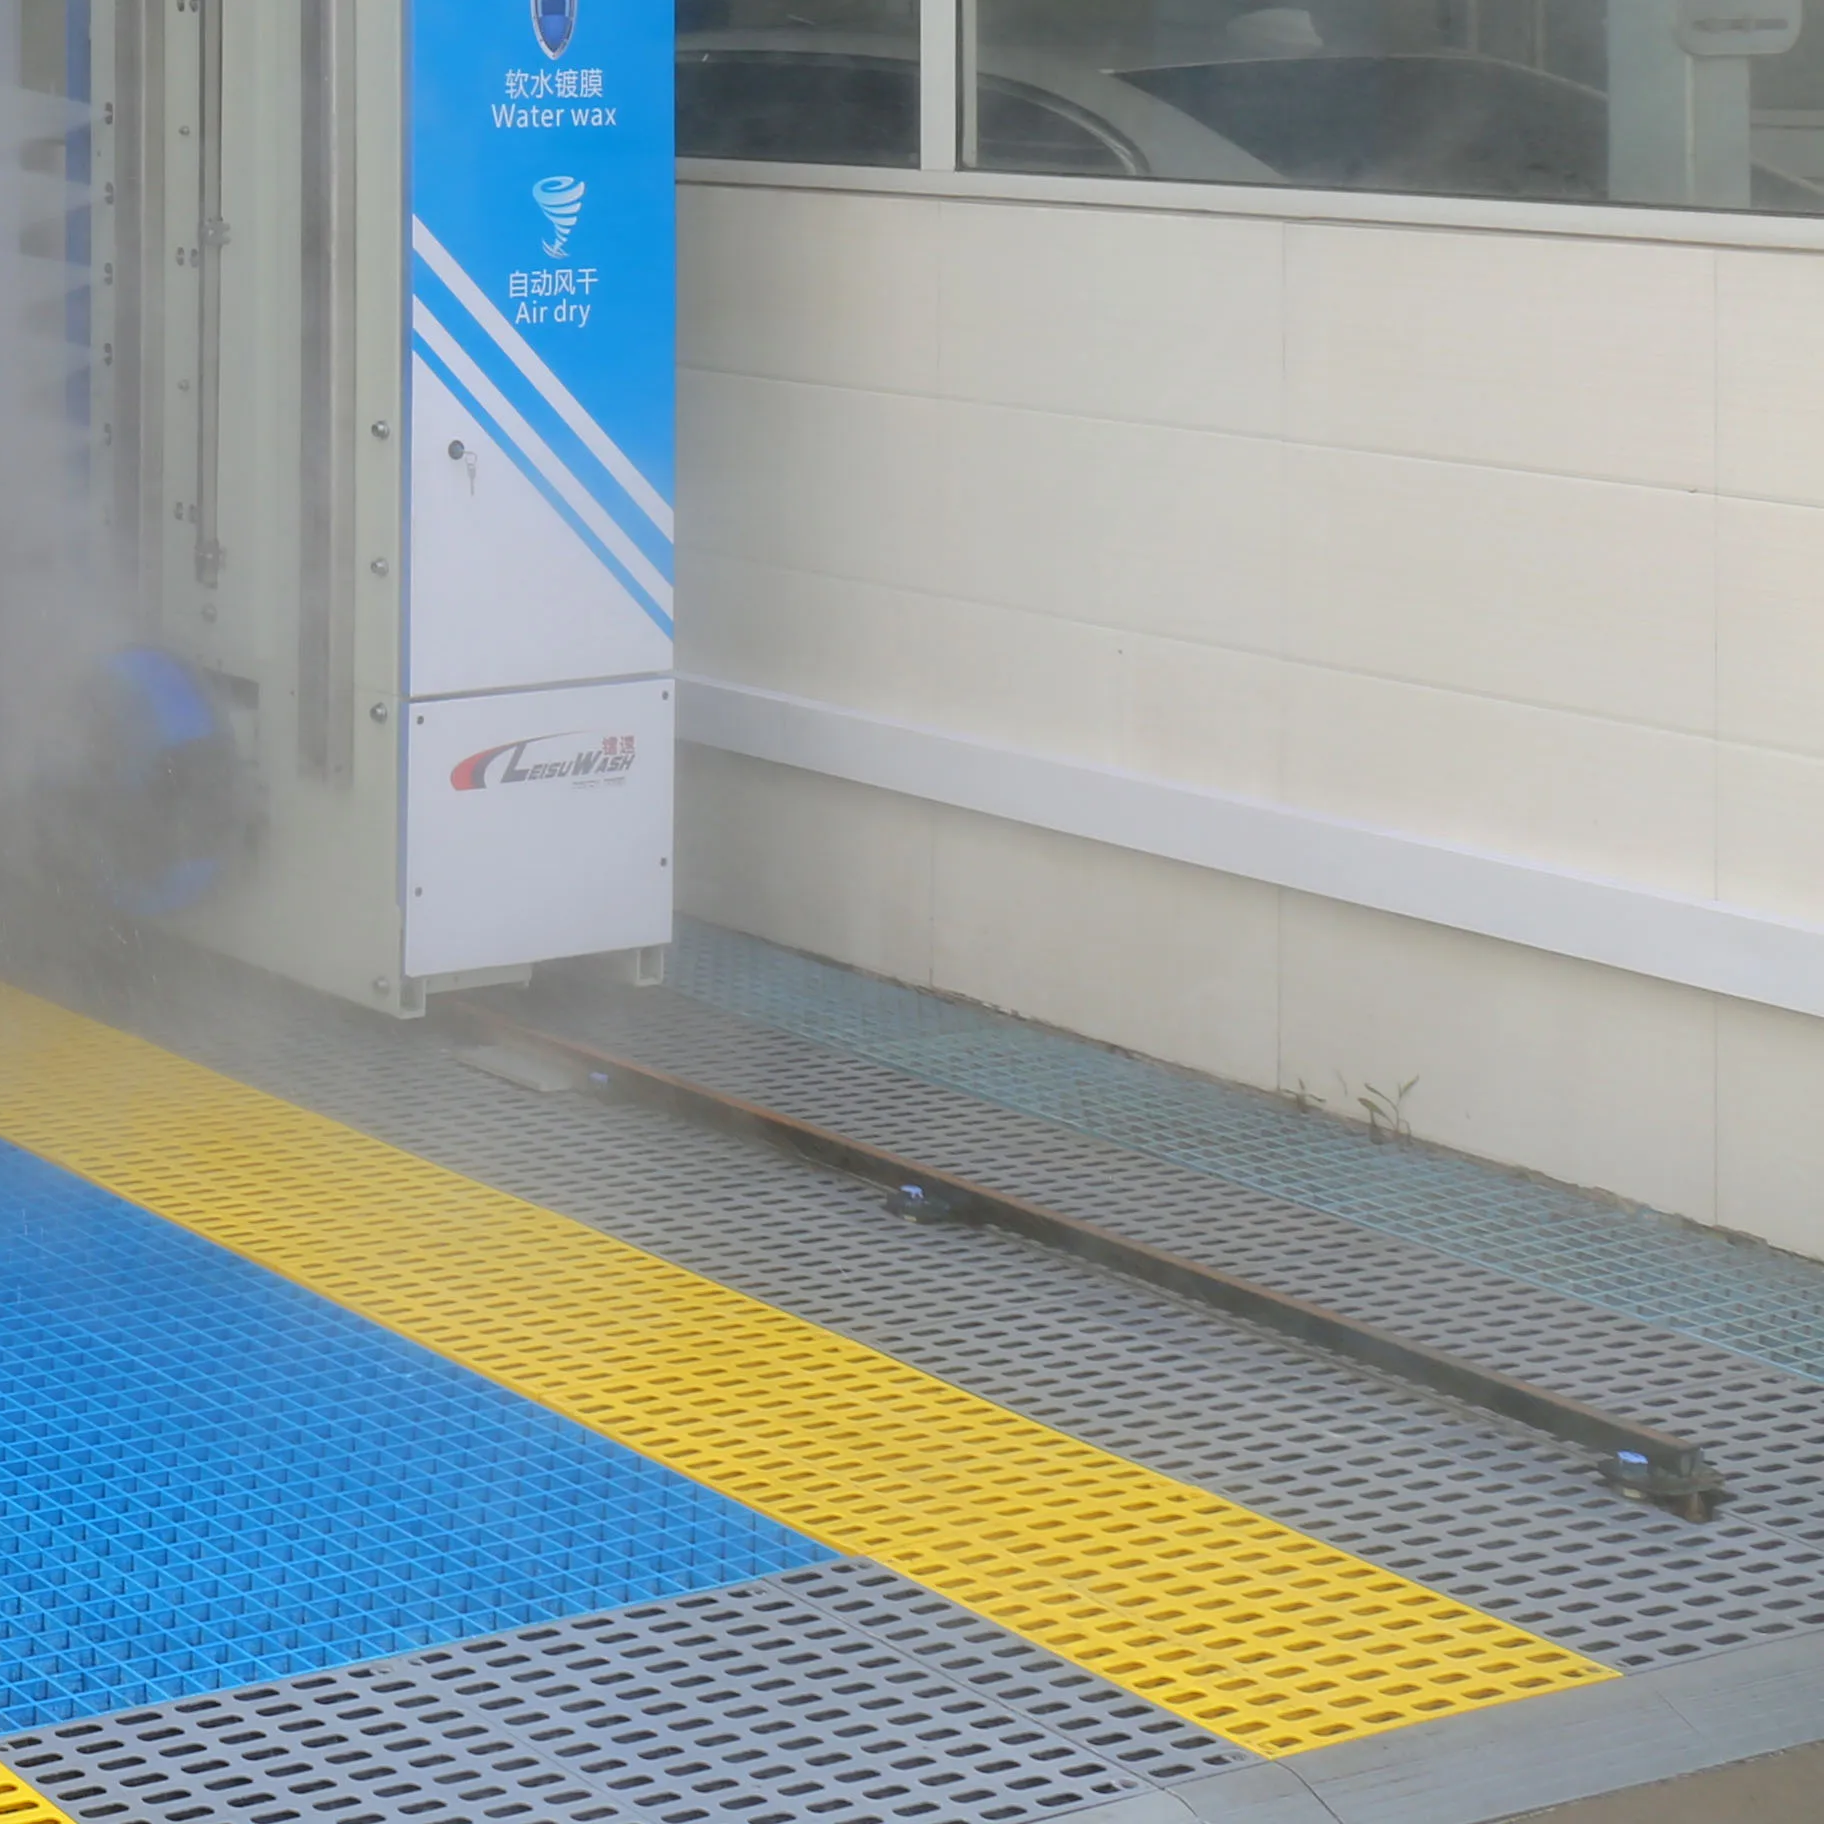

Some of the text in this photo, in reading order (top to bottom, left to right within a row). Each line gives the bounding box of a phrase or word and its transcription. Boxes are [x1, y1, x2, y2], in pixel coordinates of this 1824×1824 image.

[505, 69, 604, 100] 软水镀膜
[492, 104, 617, 129] Water wax
[508, 268, 599, 298] 自动风干
[514, 300, 591, 328] Air dry
